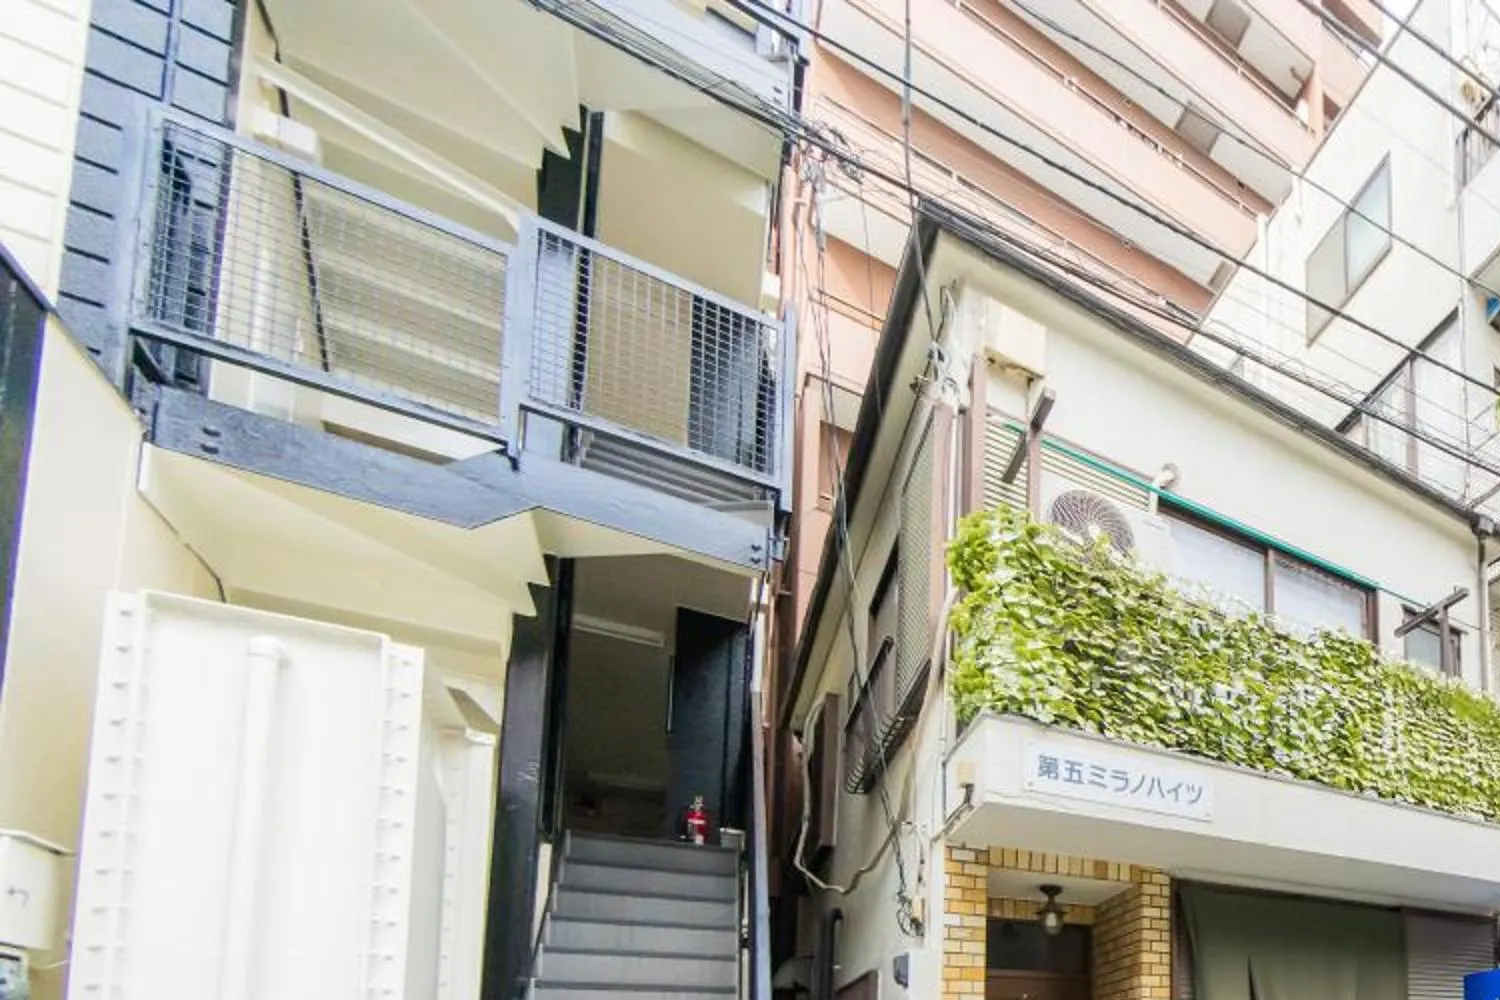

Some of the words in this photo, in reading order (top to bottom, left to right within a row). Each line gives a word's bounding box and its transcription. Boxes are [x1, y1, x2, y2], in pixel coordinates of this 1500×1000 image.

[1037, 754, 1204, 804] 第五ミラノハイツ
